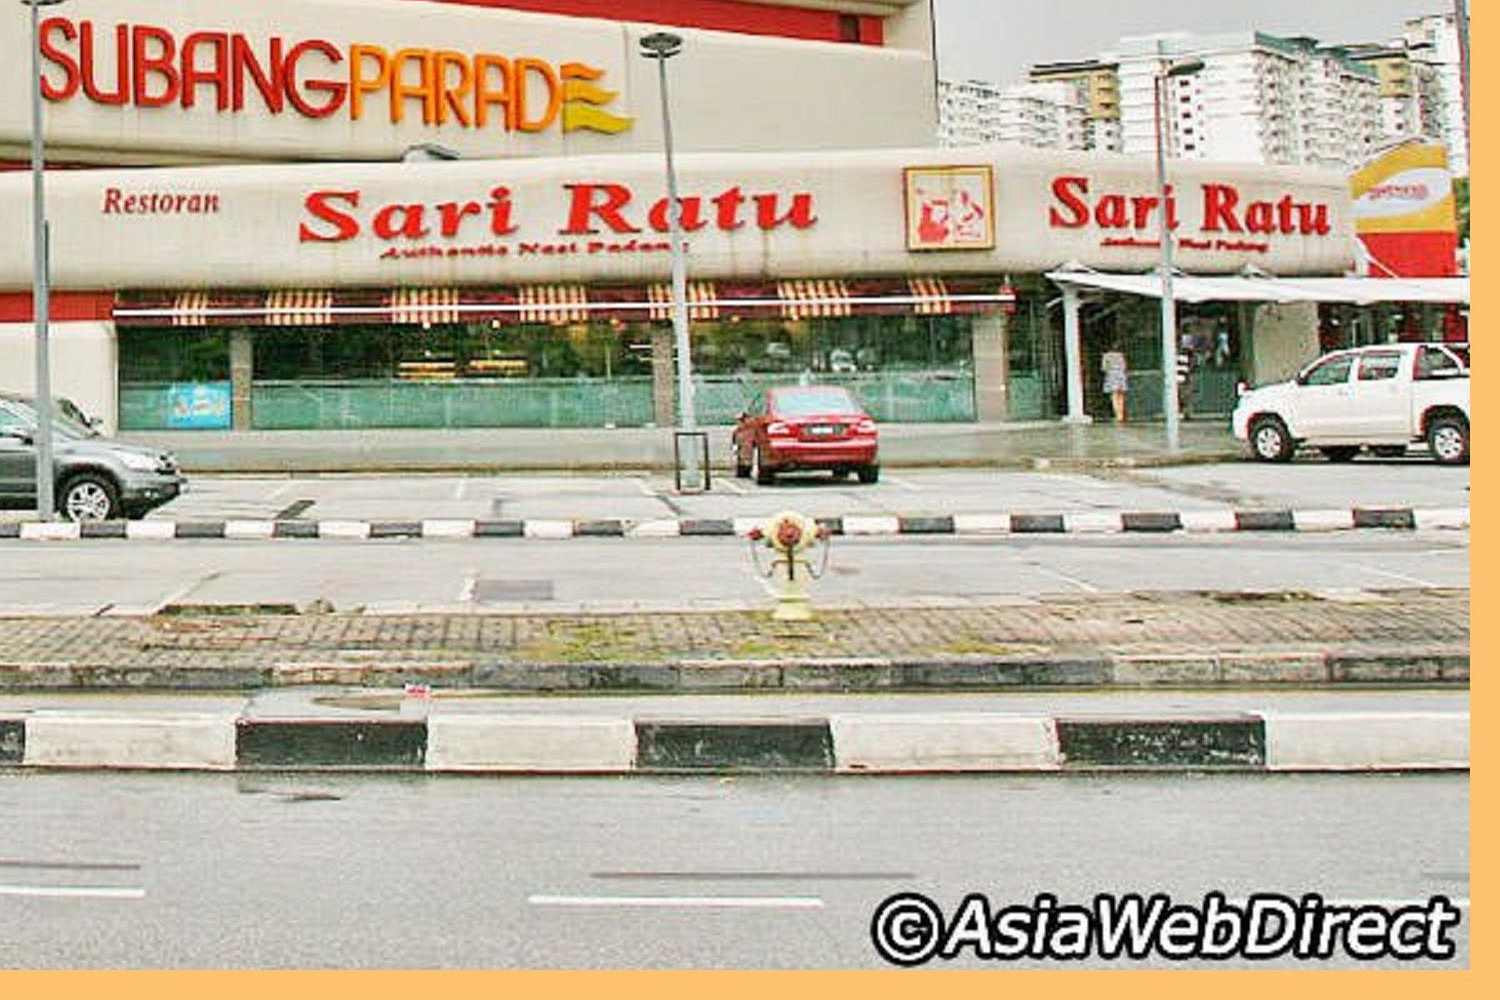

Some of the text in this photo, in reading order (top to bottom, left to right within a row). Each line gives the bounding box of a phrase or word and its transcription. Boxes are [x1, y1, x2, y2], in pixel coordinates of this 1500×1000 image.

[102, 187, 221, 214] Restoran
[299, 182, 819, 243] Sari Ratu
[1049, 175, 1331, 236] Sari Ratu
[587, 239, 690, 255] Padan
